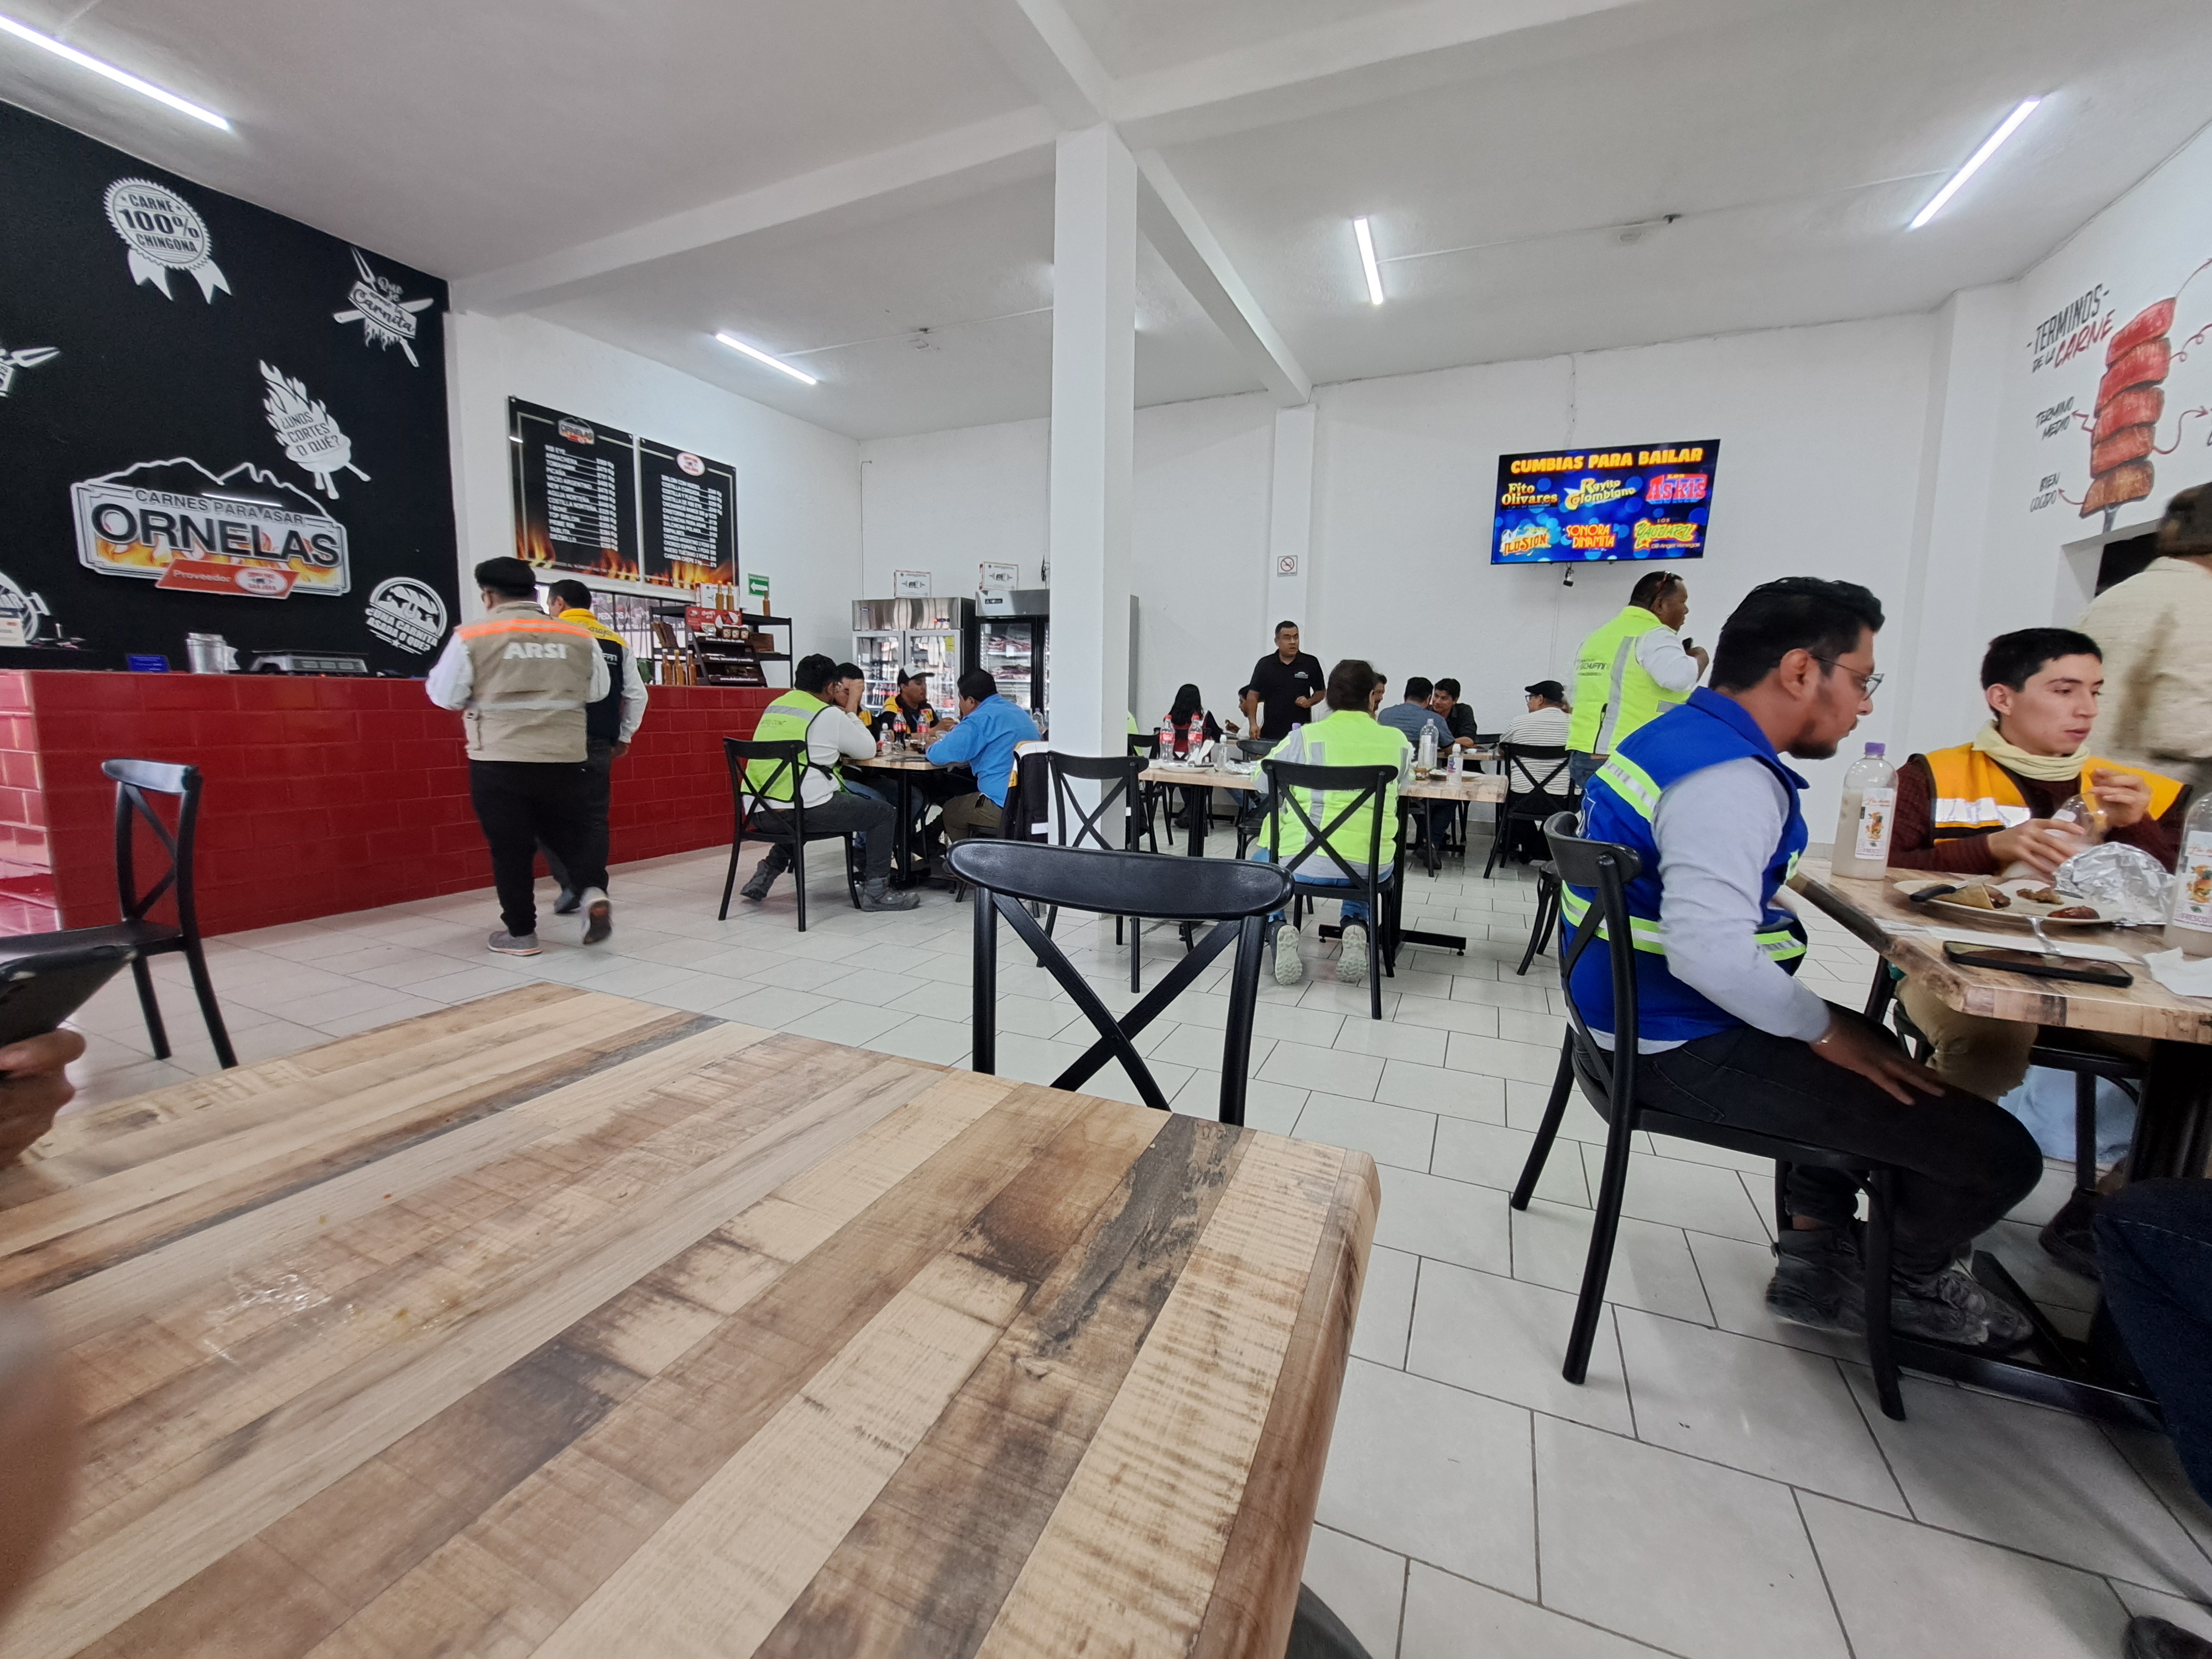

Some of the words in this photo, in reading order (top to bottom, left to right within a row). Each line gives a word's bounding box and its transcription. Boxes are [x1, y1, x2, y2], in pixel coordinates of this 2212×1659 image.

[128, 194, 175, 213] CARNE
[118, 208, 200, 238] 100%
[135, 233, 198, 253] CHINGONA
[354, 289, 415, 332] Carnita
[2054, 309, 2116, 369] CARNE
[280, 411, 314, 429] ¿UNOS
[287, 422, 331, 444] CORTES
[296, 445, 309, 456] O
[1511, 456, 1585, 474] CUMBIAS
[1588, 452, 1633, 469] PARA
[1638, 447, 1704, 466] BAILAR
[1508, 482, 1536, 494] Fito
[1580, 478, 1621, 494] Rayito
[135, 489, 208, 512] CARNES
[214, 503, 258, 519] PARA
[263, 508, 304, 525] ASAR
[1501, 493, 1558, 505] Olivares
[1564, 487, 1637, 510] Colombiano
[91, 502, 341, 567] ORNELAS
[1566, 524, 1611, 538] SONORA
[1503, 533, 1548, 557] ILUSION
[1572, 535, 1616, 549] DINAMITA
[173, 570, 232, 582] Proveedor
[364, 607, 395, 626] ¿UNA
[395, 620, 439, 647] CARNITA
[366, 617, 399, 638] ASADA
[398, 632, 407, 641] O
[503, 642, 567, 659] ARSI
